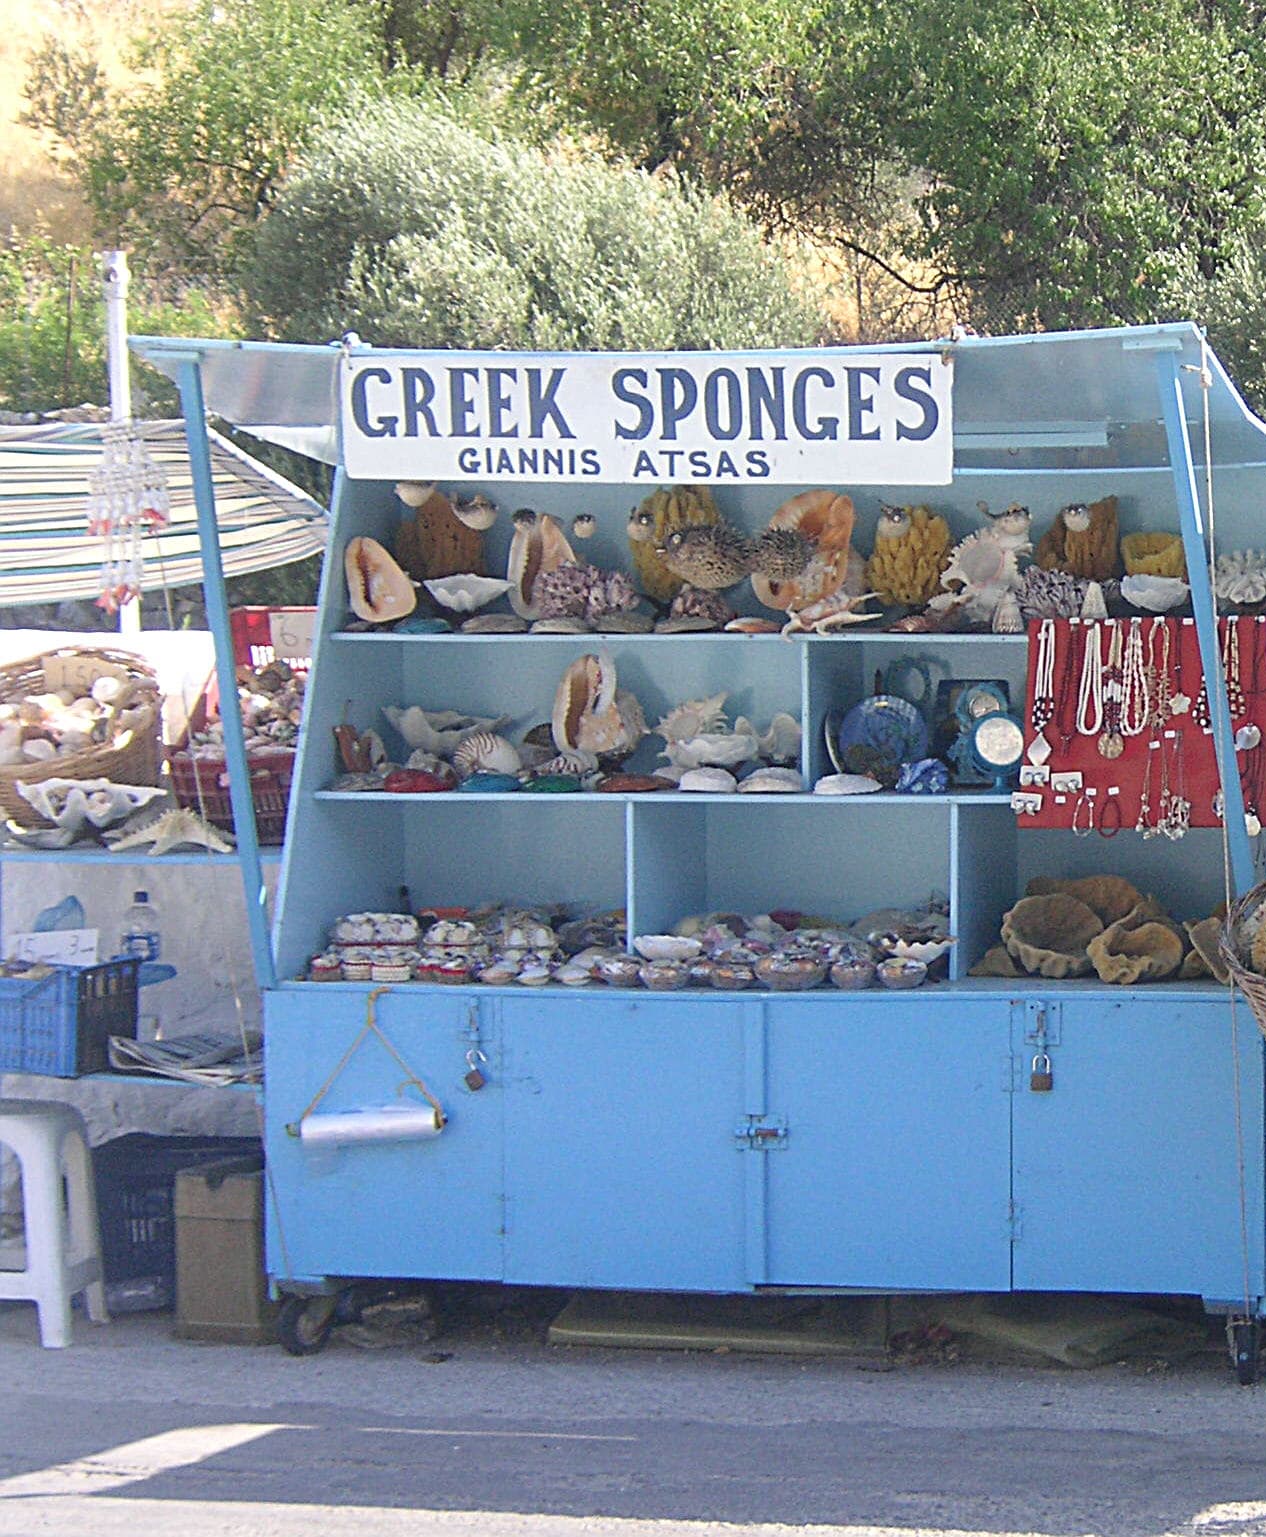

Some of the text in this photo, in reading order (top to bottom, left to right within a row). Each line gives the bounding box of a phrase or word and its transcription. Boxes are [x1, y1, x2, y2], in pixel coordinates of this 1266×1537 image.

[351, 366, 940, 442] GREEK SPONGES
[458, 448, 771, 478] GIANNIS ATSAS
